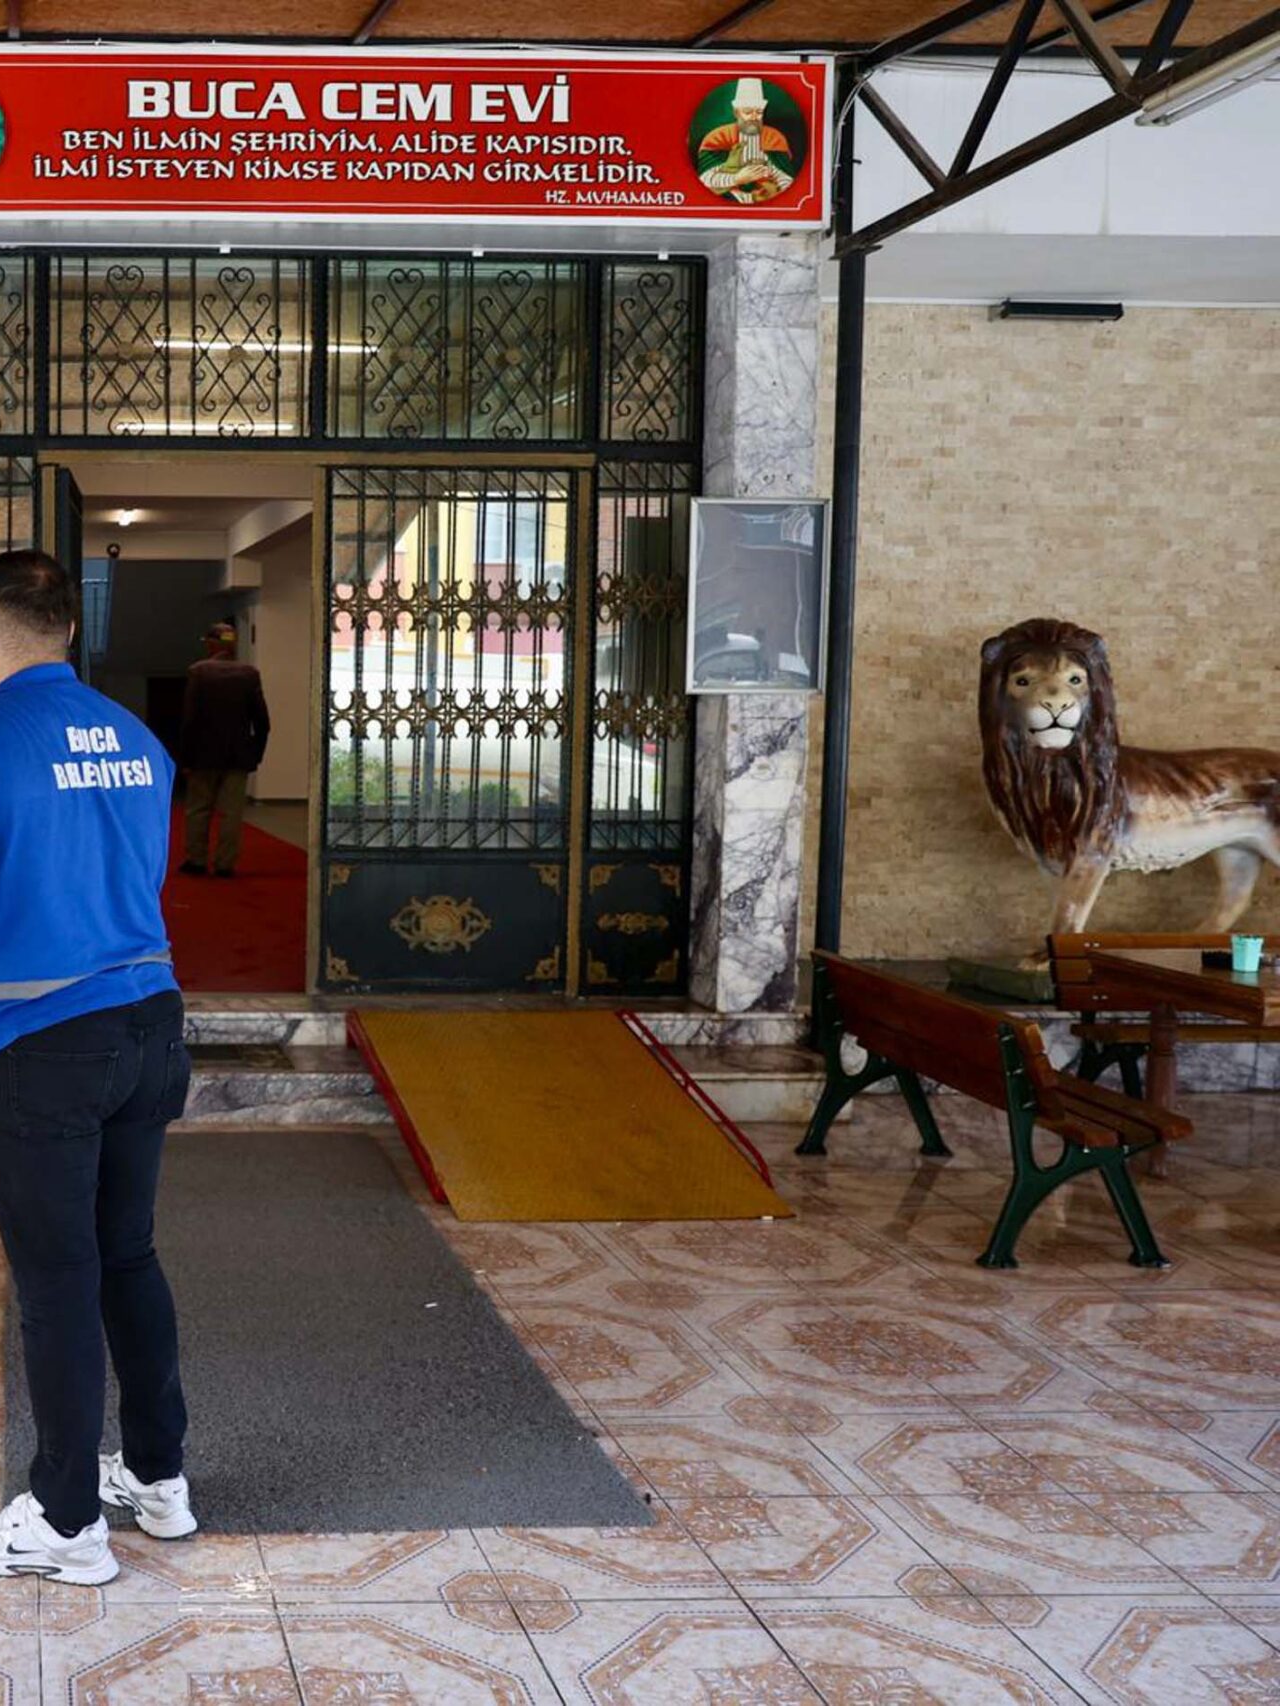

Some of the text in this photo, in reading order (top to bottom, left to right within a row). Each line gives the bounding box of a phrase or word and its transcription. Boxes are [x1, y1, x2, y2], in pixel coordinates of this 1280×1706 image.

[127, 74, 570, 123] BUCA CEM EVİ
[63, 127, 632, 156] BEN İLMİN ŞEHRİYİM. ALİDE KAPISIDIR.
[34, 154, 660, 184] İLMİ İSTEYEN KİMSE KAPIDAN GİRMELİDİR.
[545, 190, 570, 204] HZ.
